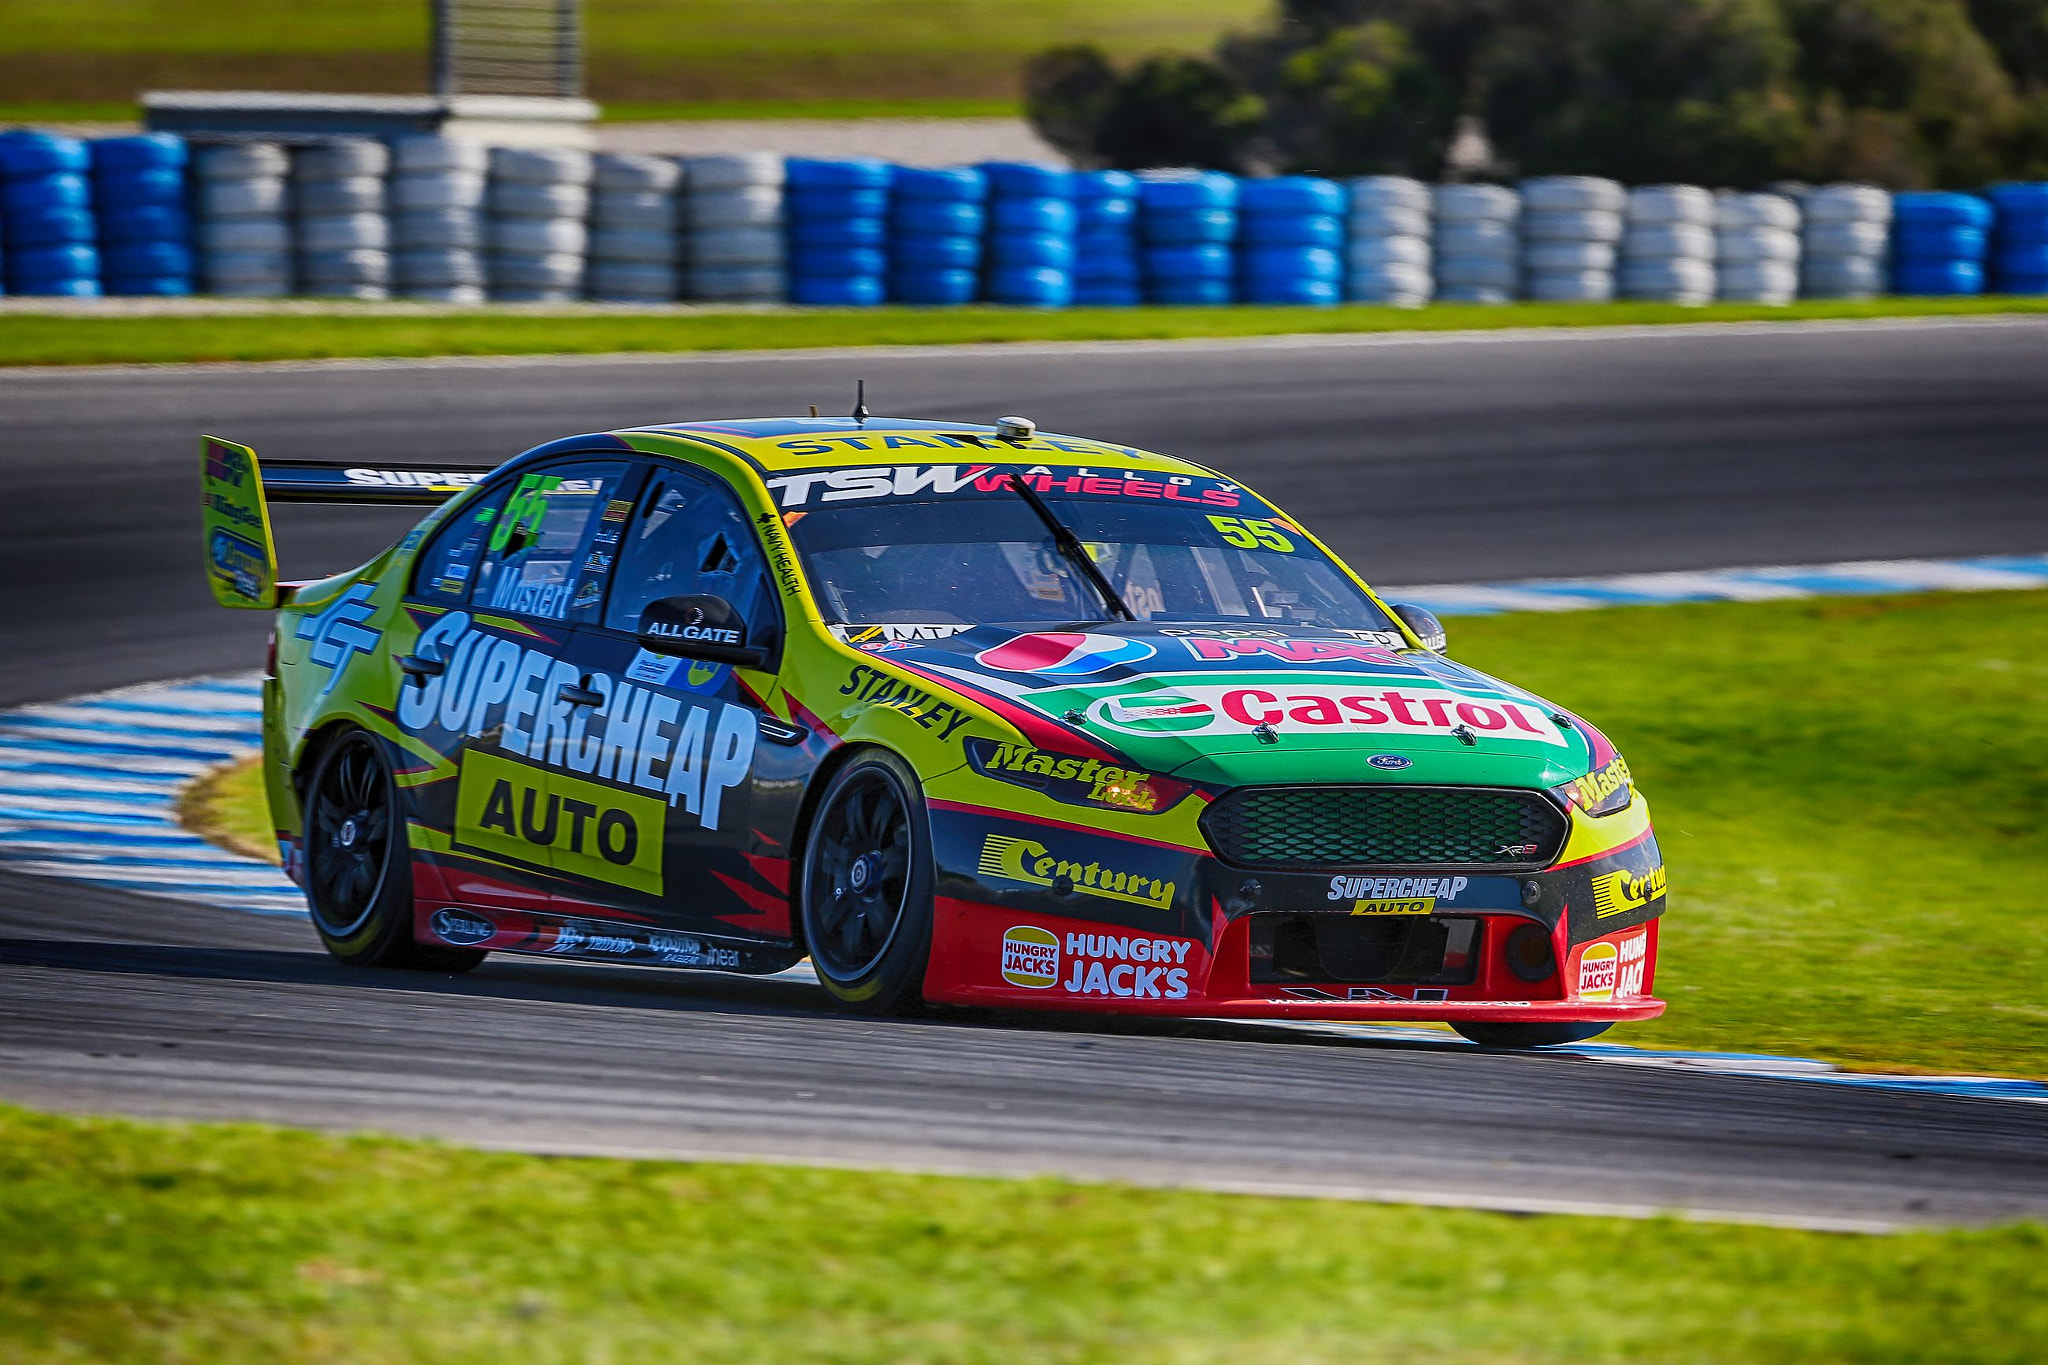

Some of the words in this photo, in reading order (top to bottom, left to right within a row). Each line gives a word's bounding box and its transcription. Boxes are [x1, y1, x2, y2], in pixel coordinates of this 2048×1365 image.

[766, 465, 998, 507] TSW
[967, 466, 1241, 508] WHEELS
[1025, 465, 1241, 493] ALLOY
[489, 473, 564, 552] 55
[762, 523, 786, 552] NAVY
[1204, 514, 1296, 553] 55
[490, 565, 576, 619] Mostert
[772, 552, 803, 597] HEALTH
[647, 622, 740, 645] ALLGATE
[1180, 637, 1414, 665] MAX
[399, 609, 757, 831] SUPERCHEAP
[839, 664, 974, 742] STANLEY
[1221, 688, 1547, 736] Castrol
[985, 742, 1151, 791] Master
[1087, 781, 1157, 811] Lock
[479, 777, 639, 867] AUTO
[977, 833, 1176, 911] Century
[1327, 875, 1468, 901] SUPERCHEAP
[1362, 901, 1425, 913] AUTO
[1004, 954, 1056, 976] JACK'S
[1005, 941, 1057, 959] HUNGRY
[1066, 932, 1192, 964] HUNGRY
[1582, 960, 1616, 974] HUNGRY
[1063, 959, 1190, 999] JACK'S
